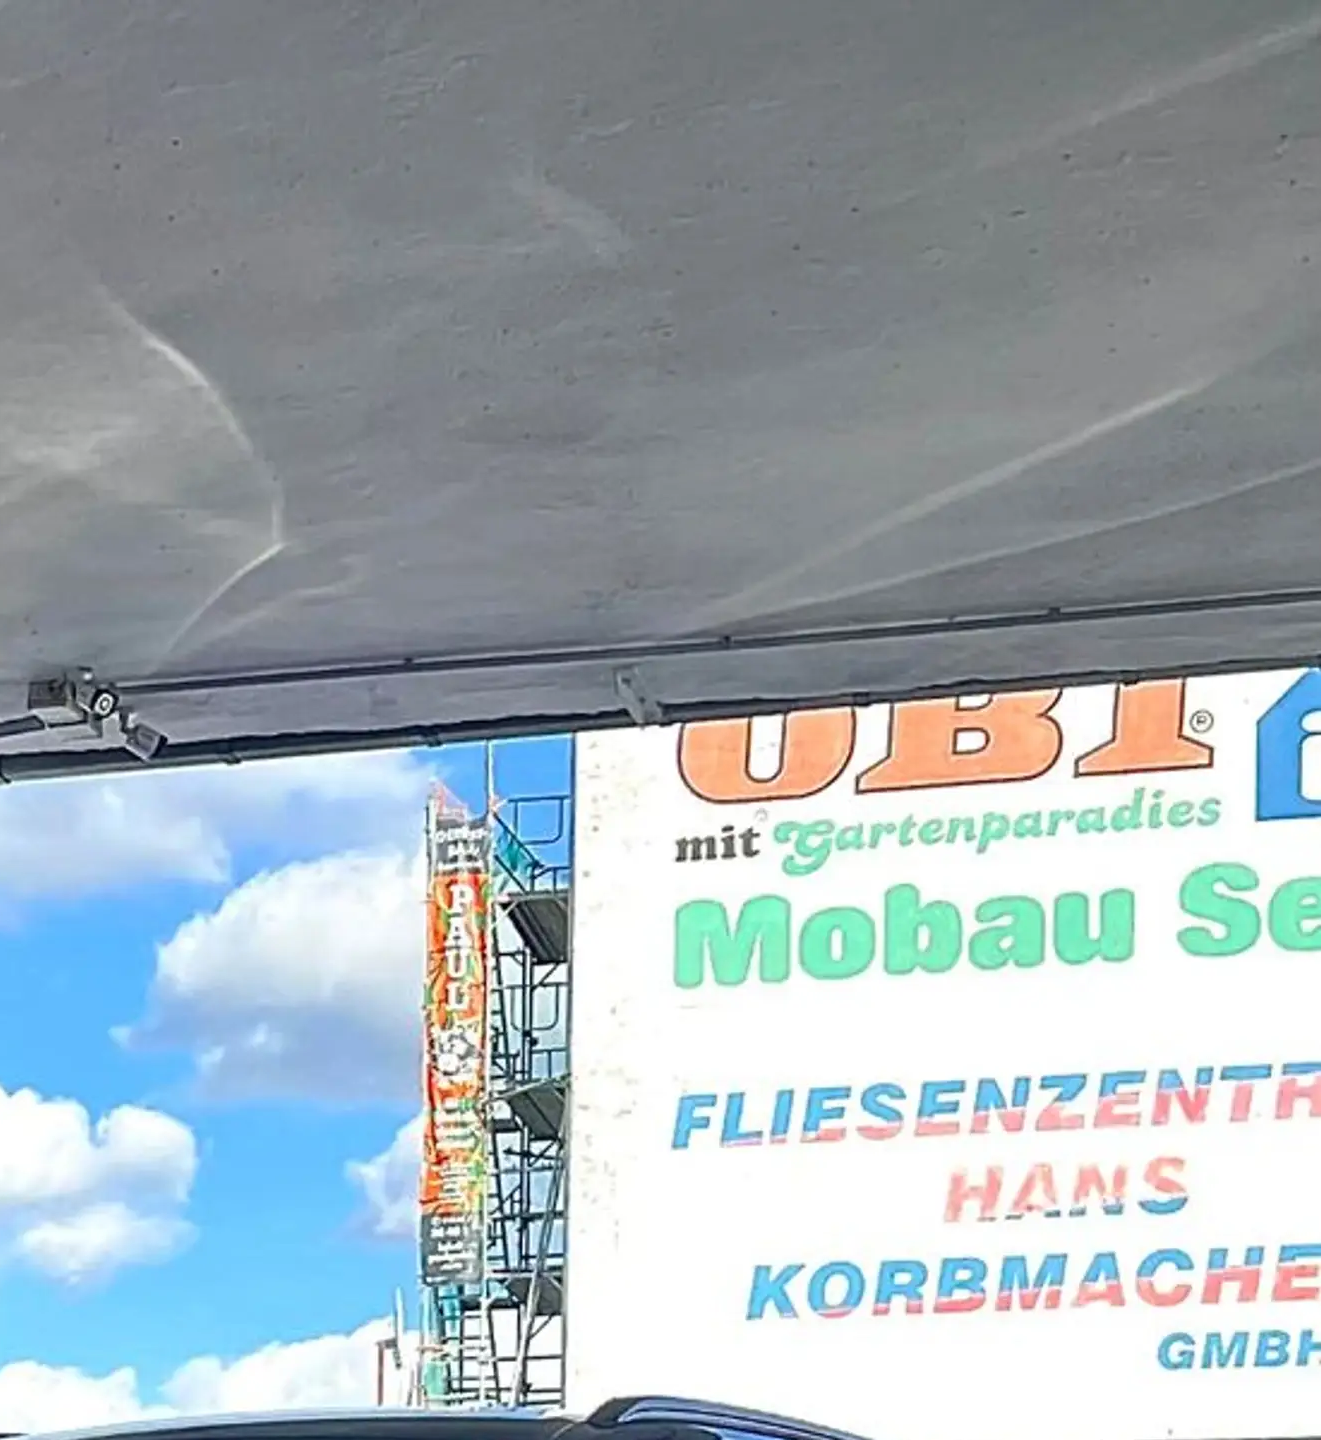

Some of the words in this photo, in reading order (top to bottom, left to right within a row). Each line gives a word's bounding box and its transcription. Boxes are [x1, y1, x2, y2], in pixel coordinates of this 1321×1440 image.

[675, 825, 760, 862] mit
[773, 787, 1222, 876] Gartenparadies
[673, 883, 1135, 989] Mobau
[943, 1156, 1190, 1223] HANS
